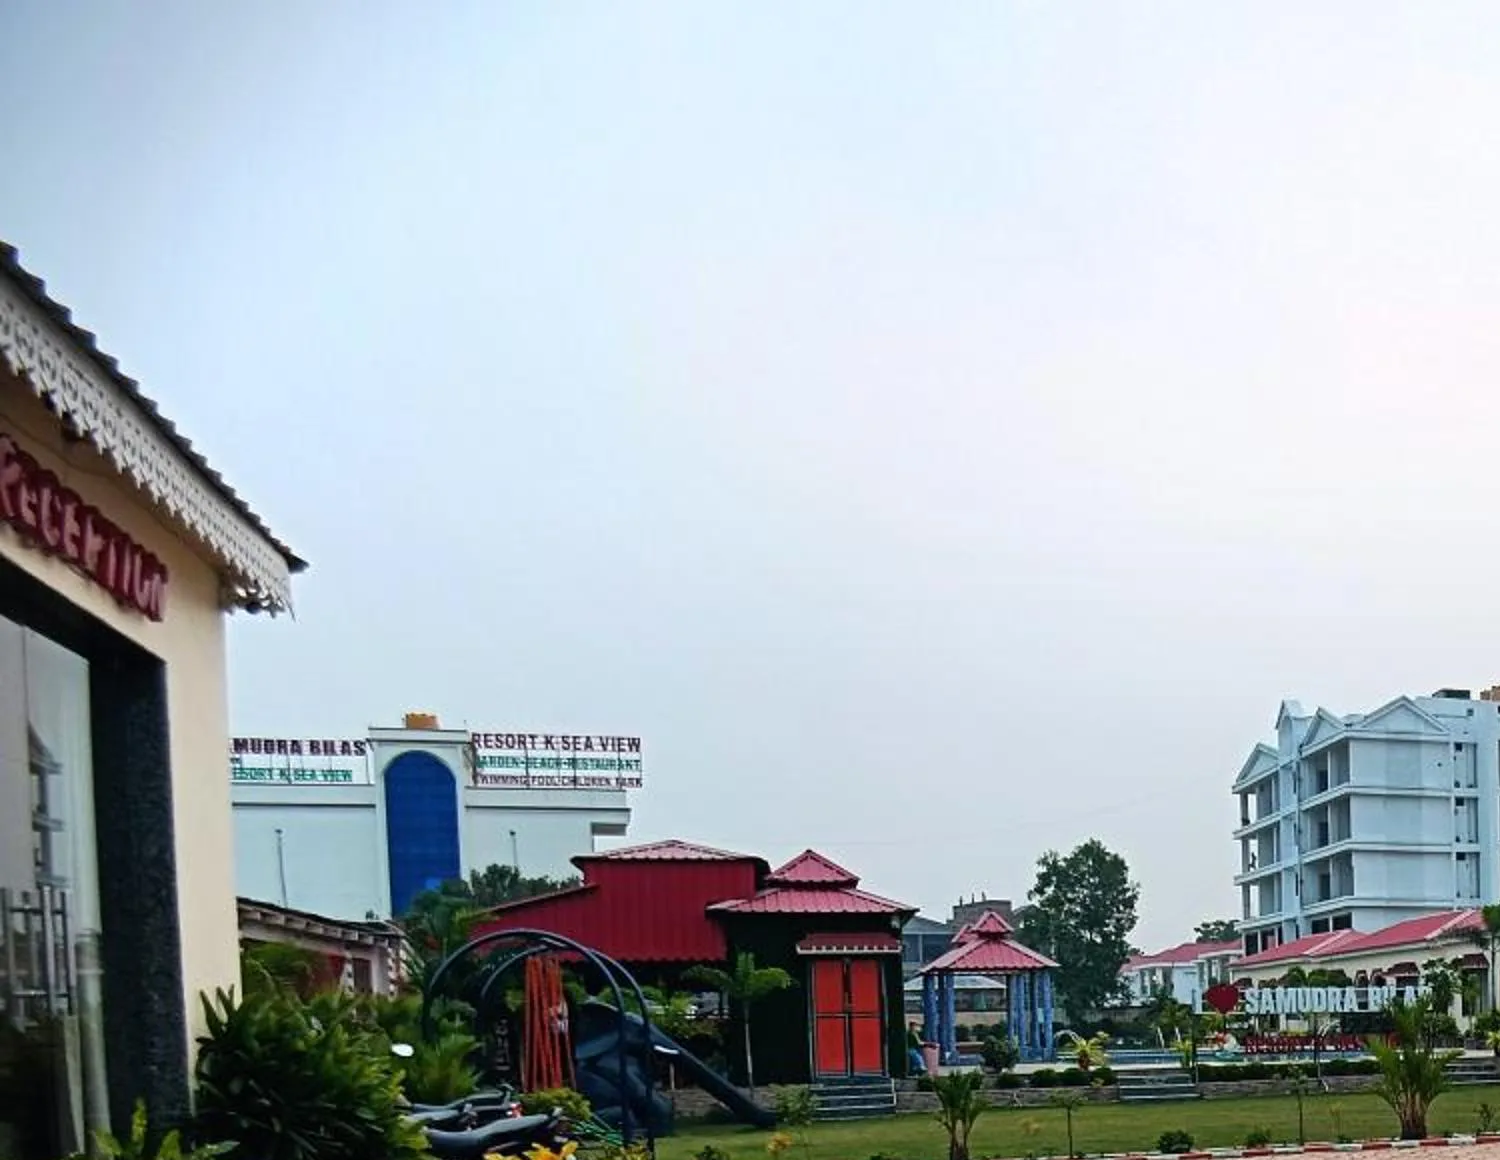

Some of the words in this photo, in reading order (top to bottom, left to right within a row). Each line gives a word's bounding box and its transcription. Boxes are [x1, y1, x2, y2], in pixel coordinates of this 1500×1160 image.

[231, 738, 302, 756] MUDRA
[309, 739, 366, 756] BILAS
[472, 733, 538, 750] RESORT
[545, 735, 555, 750] K
[561, 735, 593, 751] SEA
[597, 736, 641, 753] VIEW
[1245, 985, 1359, 1014] SAMUDRA
